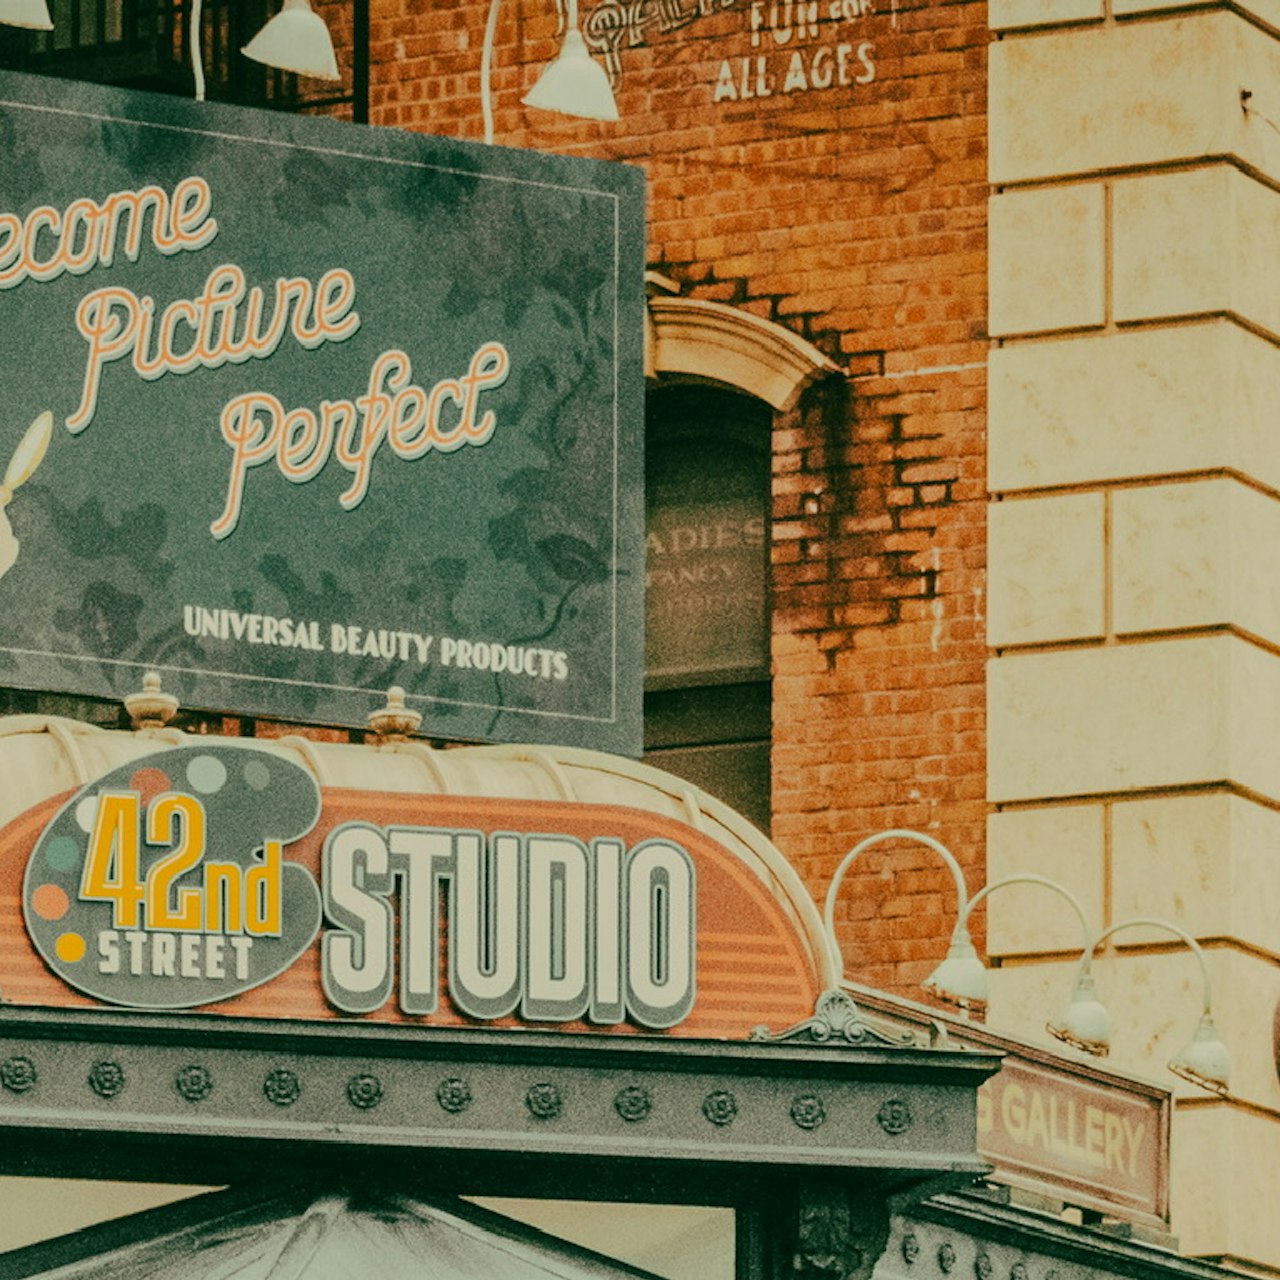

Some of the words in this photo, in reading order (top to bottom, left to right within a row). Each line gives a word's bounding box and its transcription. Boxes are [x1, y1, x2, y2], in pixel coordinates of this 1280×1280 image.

[714, 56, 772, 102] ALL
[783, 42, 876, 93] AGES
[65, 263, 360, 433] Picture
[211, 342, 510, 540] Perfect
[183, 605, 324, 652] UNIVERSAL
[330, 625, 434, 664] BEAUTY
[439, 640, 569, 682] PRODUCTS
[80, 789, 283, 938] 42nd
[322, 821, 696, 1028] STUDIO
[96, 930, 253, 981] STREET
[1001, 1081, 1145, 1178] GALLERY
